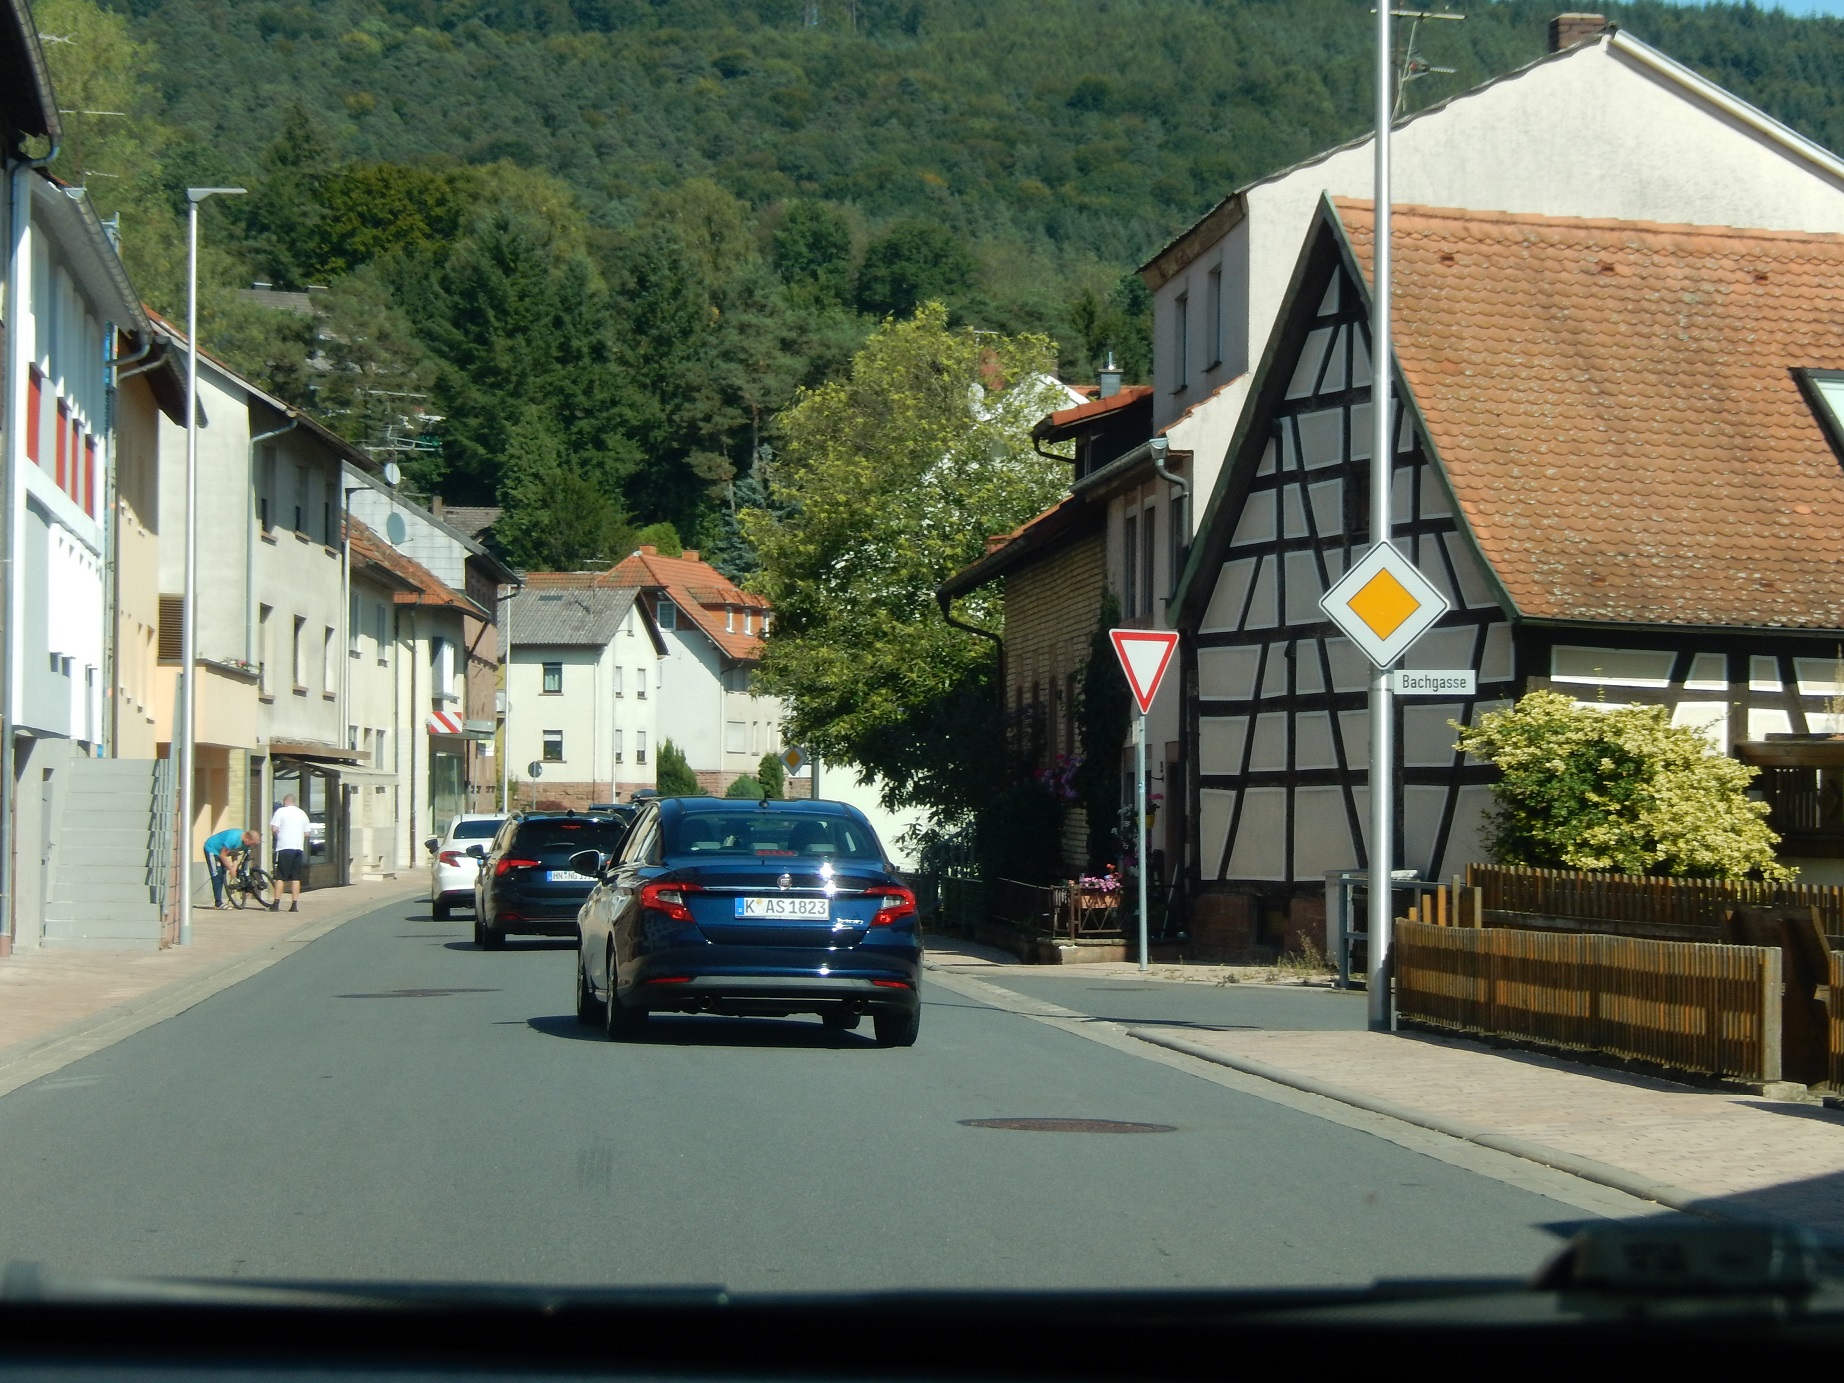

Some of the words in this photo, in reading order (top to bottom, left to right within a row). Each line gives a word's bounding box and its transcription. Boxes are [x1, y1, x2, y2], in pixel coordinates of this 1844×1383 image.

[1402, 674, 1466, 692] Bachgasse
[553, 872, 563, 880] HN
[745, 899, 755, 913] K
[766, 899, 785, 914] AS
[788, 900, 826, 915] 1823
